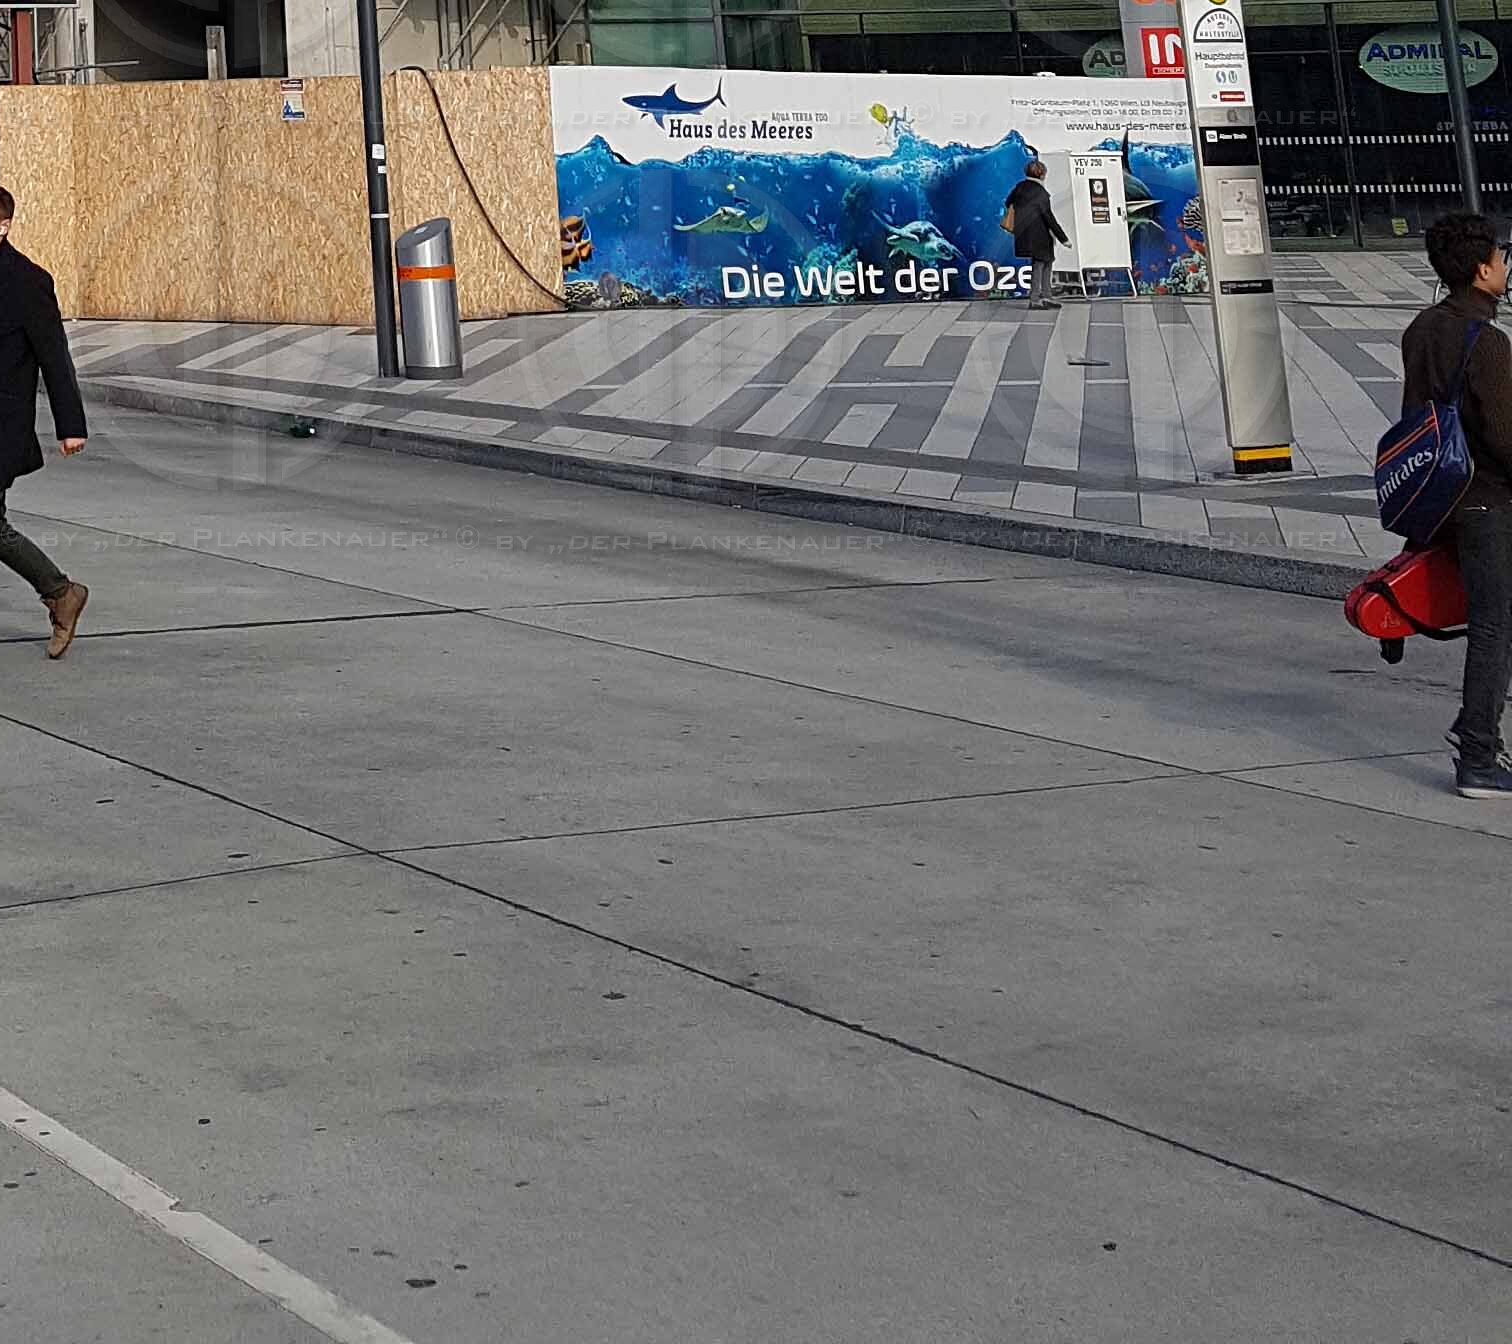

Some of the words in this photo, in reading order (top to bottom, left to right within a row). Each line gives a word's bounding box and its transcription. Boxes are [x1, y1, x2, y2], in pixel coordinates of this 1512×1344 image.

[669, 119, 713, 138] Haus
[717, 119, 747, 139] des
[751, 120, 813, 139] Meeres
[722, 264, 785, 299] Die
[794, 260, 885, 297] Welt
[894, 260, 958, 293] der
